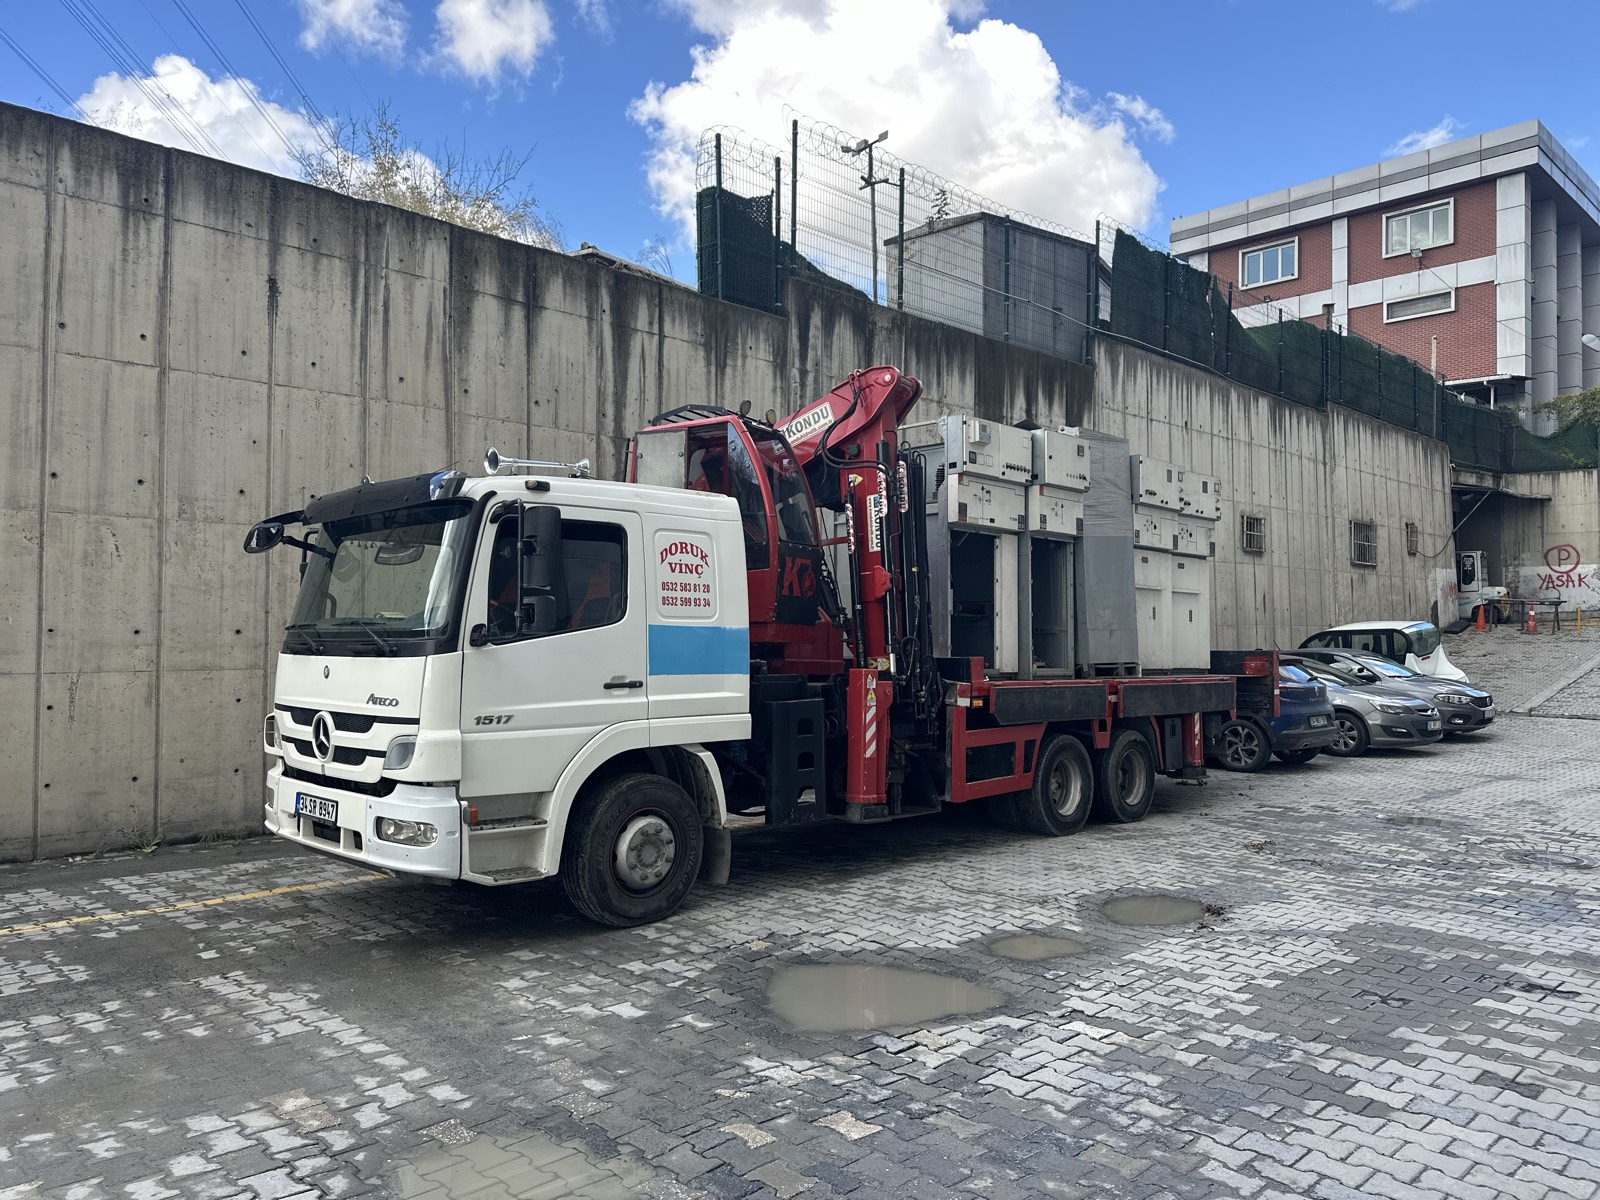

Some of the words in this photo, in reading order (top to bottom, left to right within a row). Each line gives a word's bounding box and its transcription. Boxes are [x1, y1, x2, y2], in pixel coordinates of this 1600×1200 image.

[785, 406, 829, 438] KONDU
[898, 475, 906, 509] KONDU
[659, 541, 709, 568] DORUK
[1558, 548, 1570, 567] P
[667, 558, 704, 578] VİNÇ
[661, 582, 678, 592] 0532
[680, 582, 692, 593] 583
[693, 583, 701, 593] 81
[702, 584, 711, 594] 20
[1536, 573, 1590, 590] YASAK
[661, 595, 678, 606] 0532
[680, 596, 692, 607] 599
[693, 597, 702, 607] 93
[702, 598, 711, 608] 34
[474, 714, 514, 726] 1517
[301, 796, 308, 812] 34
[309, 799, 317, 815] SR
